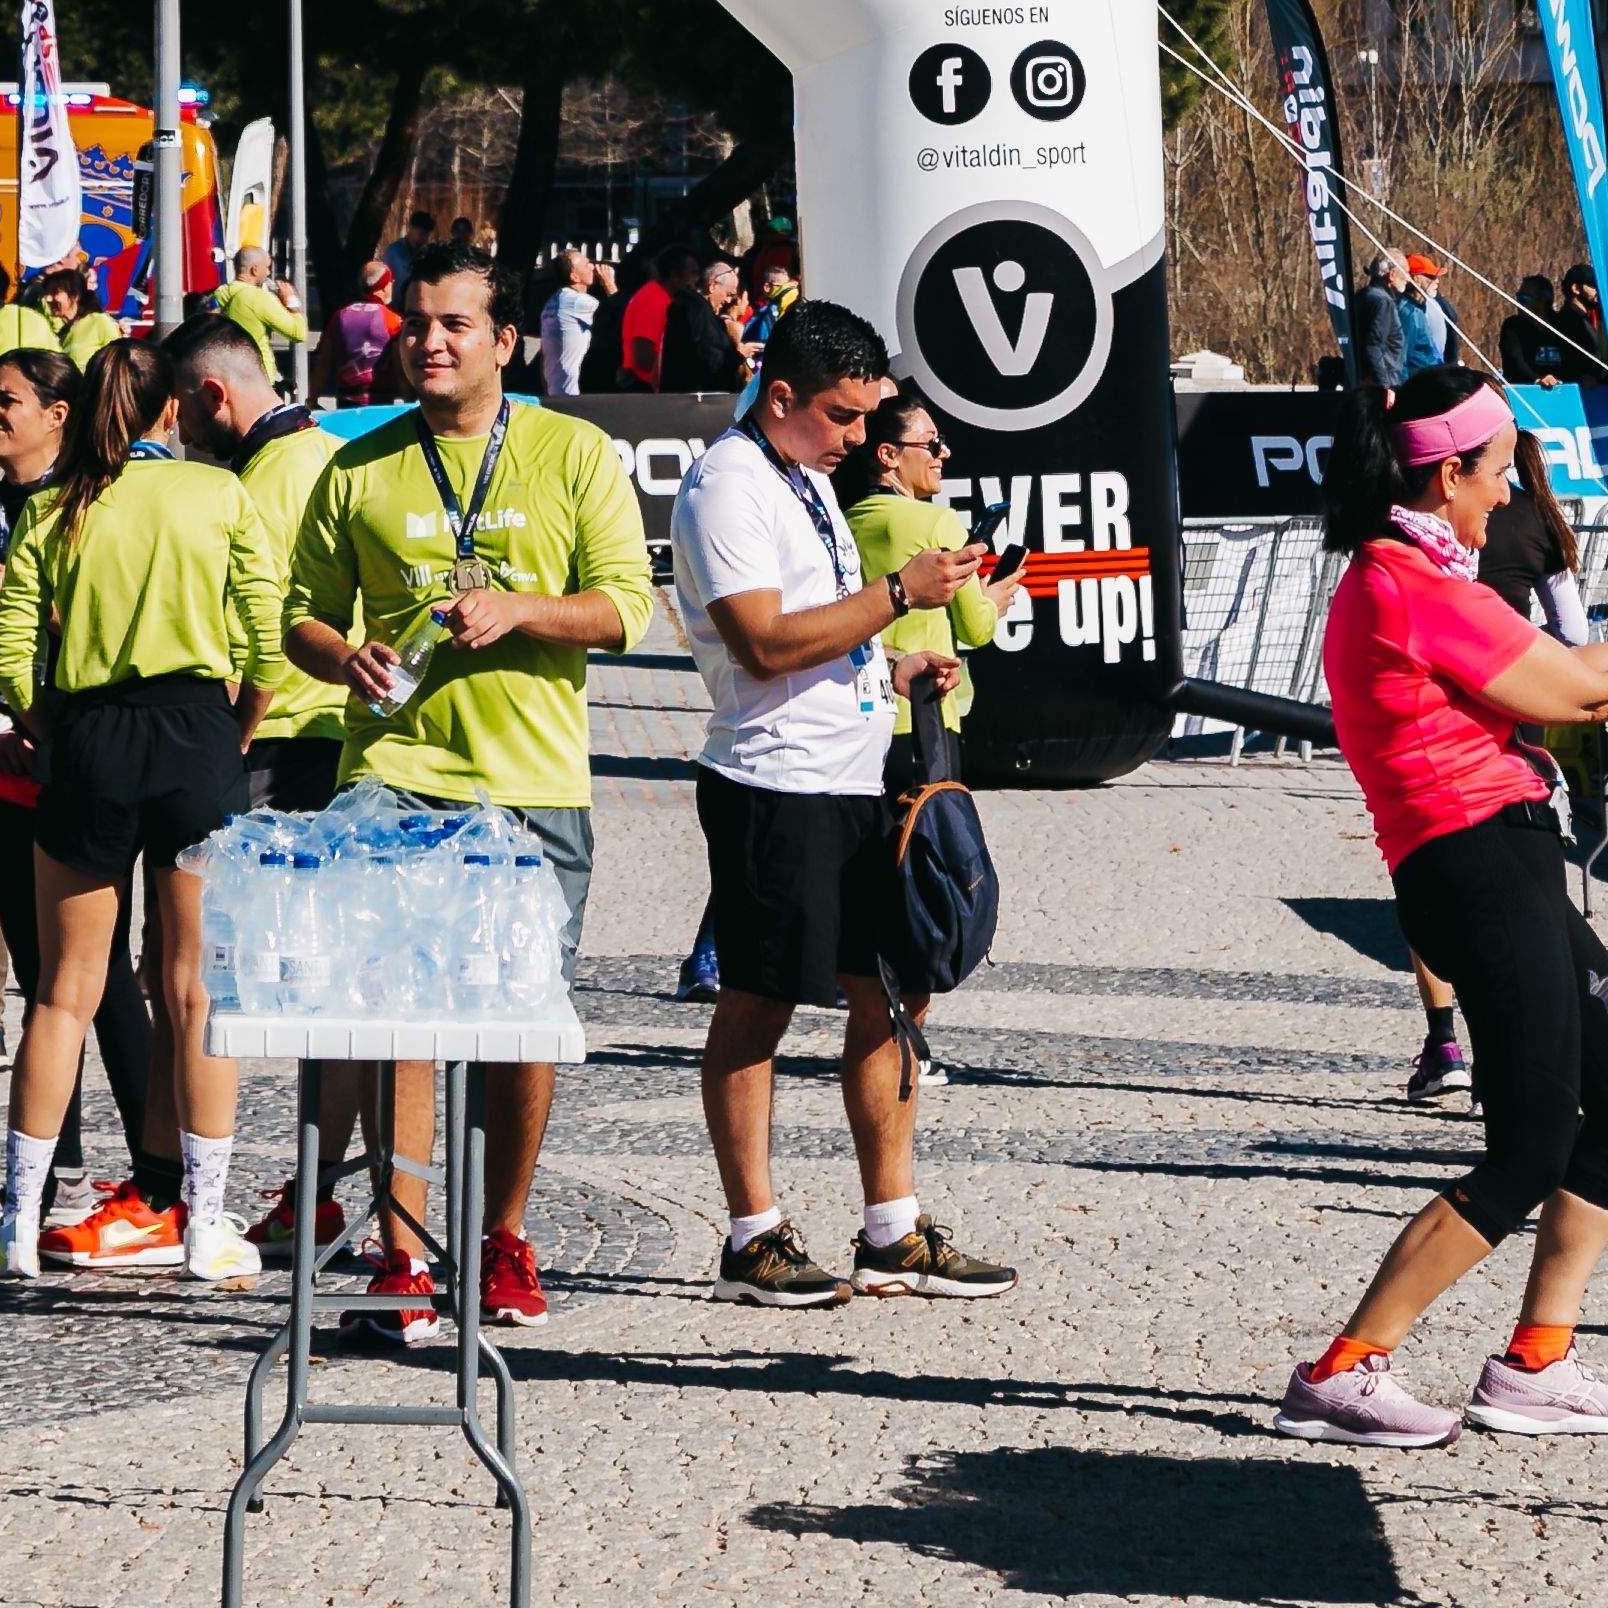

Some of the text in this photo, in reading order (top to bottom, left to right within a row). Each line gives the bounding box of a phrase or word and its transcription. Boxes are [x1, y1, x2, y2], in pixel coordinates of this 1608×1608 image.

[944, 5, 1050, 27] SÍGUENOS EN
[916, 140, 1088, 173] @vitaldin_sport
[932, 470, 1132, 555] EVER
[1057, 574, 1157, 664] up!
